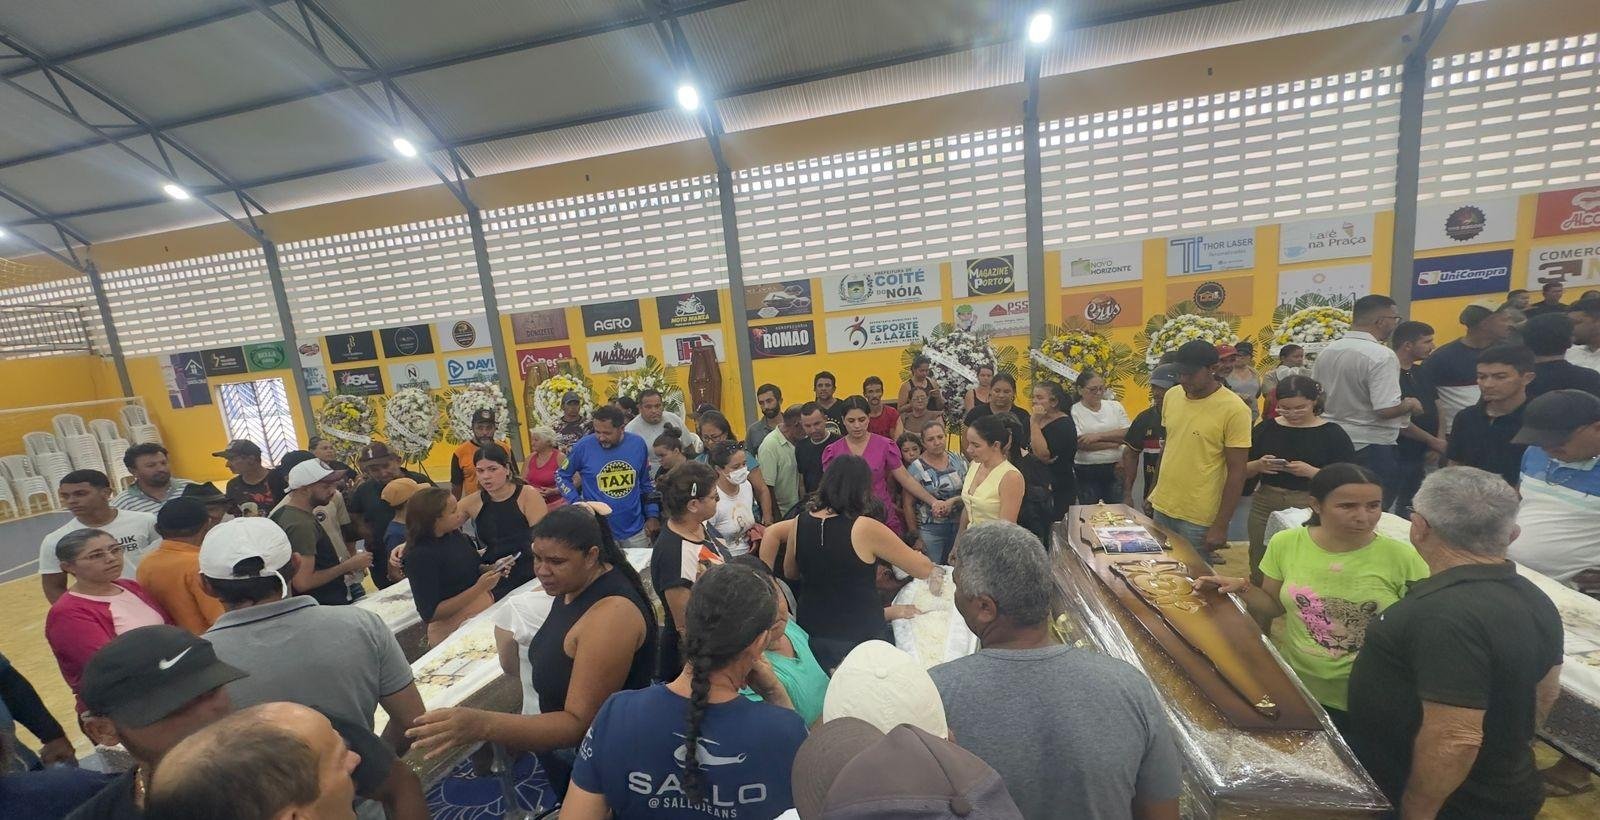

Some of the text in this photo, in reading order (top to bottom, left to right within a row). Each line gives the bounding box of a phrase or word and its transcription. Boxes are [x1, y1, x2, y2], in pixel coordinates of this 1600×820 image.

[1203, 238, 1254, 251] THOR LASER
[1329, 236, 1366, 246] Praça
[1091, 260, 1112, 268] NOVO
[1091, 265, 1133, 275] HORIZONTE
[875, 268, 926, 287] COITÉ
[969, 266, 1009, 279] MAGAZINE
[1440, 268, 1506, 281] UniCompra
[886, 285, 923, 299] NÓIA
[594, 317, 632, 331] AGRO
[870, 321, 919, 333] ESPORTE
[884, 330, 919, 341] LAZER
[592, 347, 644, 363] MUMBUCA
[466, 359, 494, 370] DAVI
[601, 474, 634, 487] TAXI
[628, 771, 767, 807] SALO
